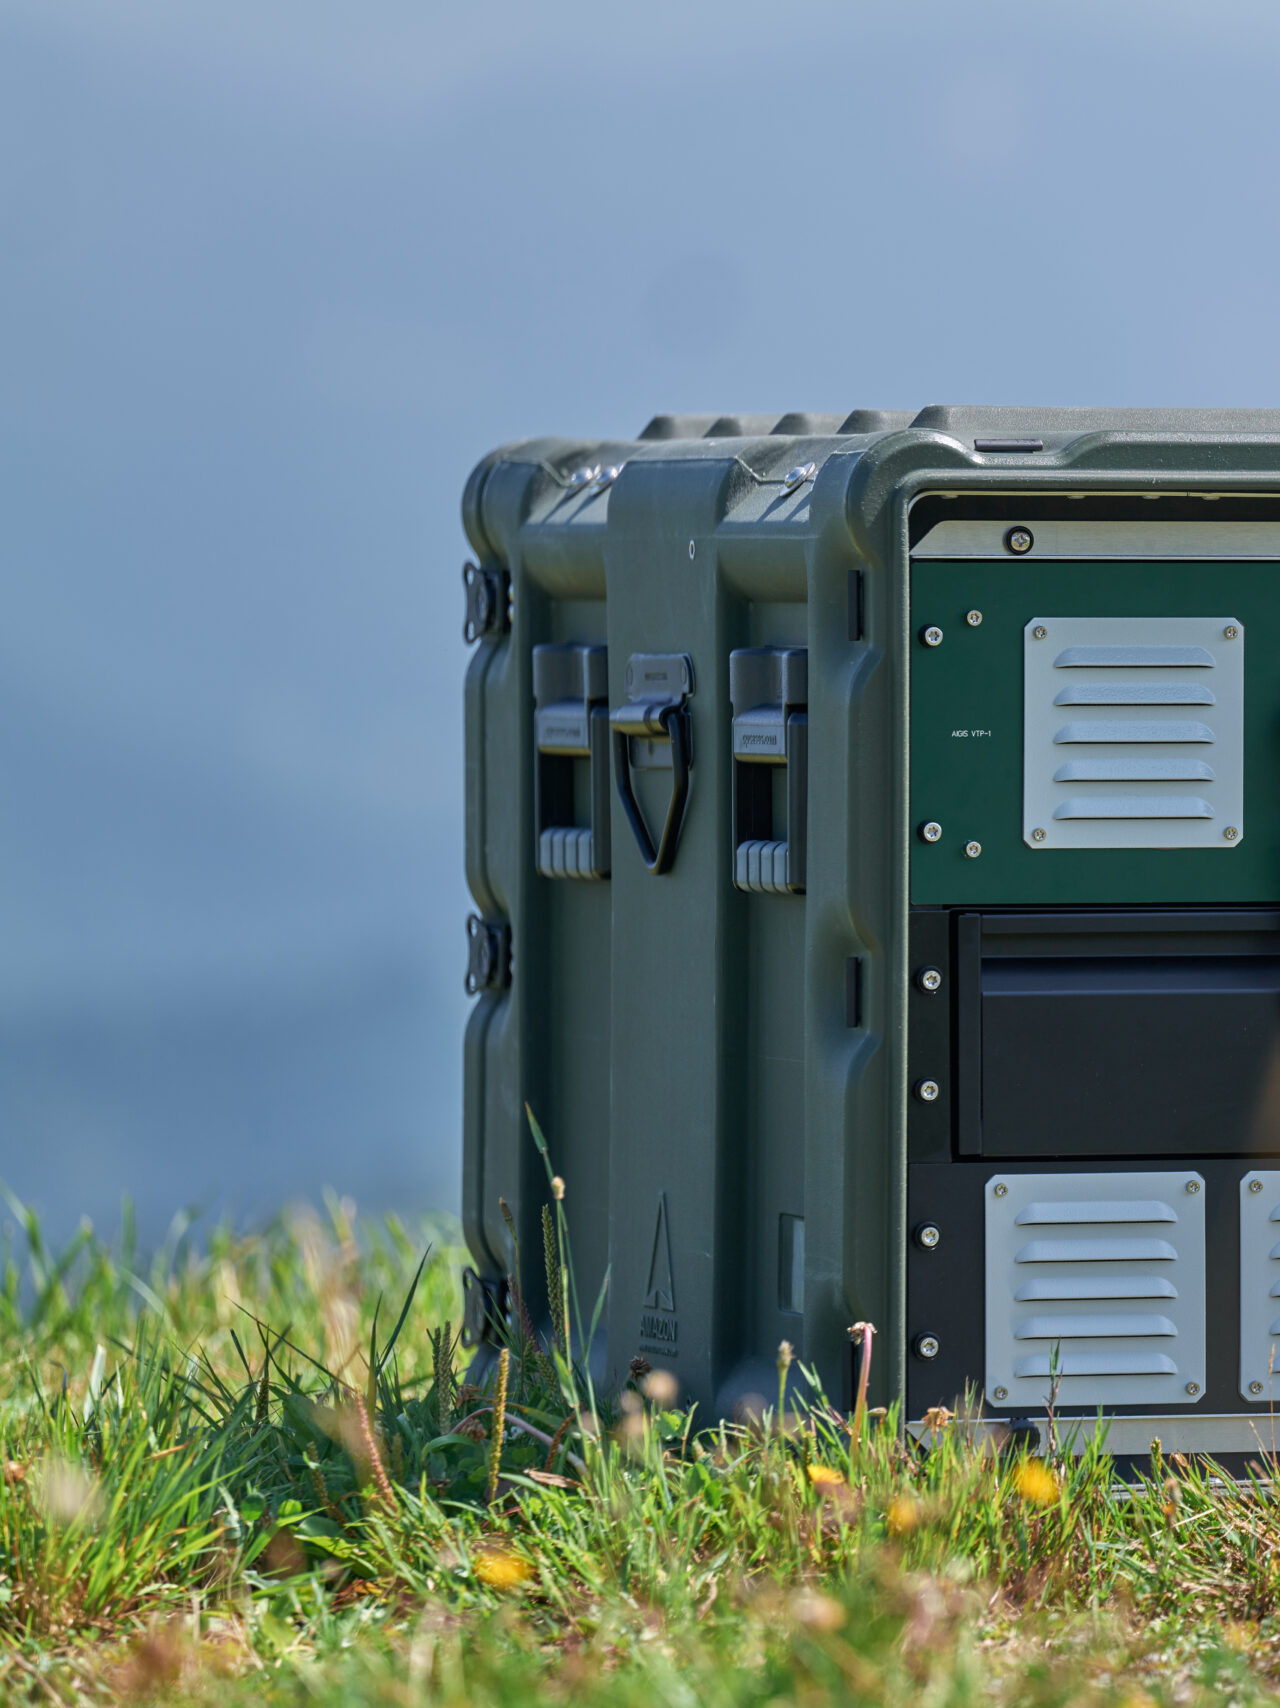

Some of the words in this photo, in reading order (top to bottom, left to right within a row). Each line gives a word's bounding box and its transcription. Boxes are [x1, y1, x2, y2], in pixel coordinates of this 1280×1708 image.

[951, 729, 969, 738] AIGIS
[971, 729, 992, 738] VTP-1
[640, 1314, 678, 1342] AMAZON
